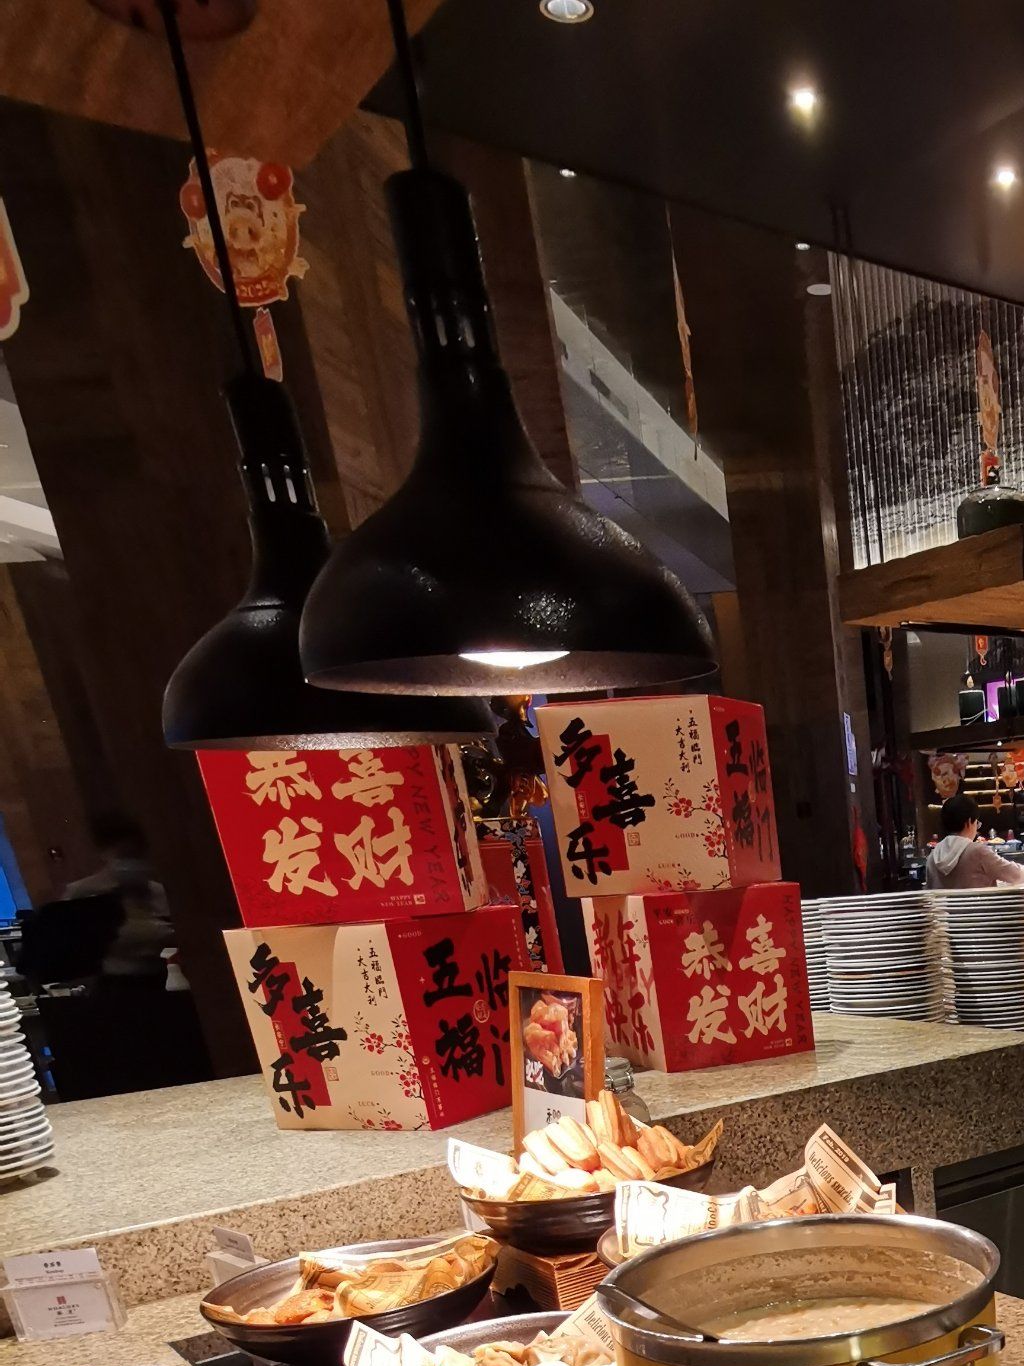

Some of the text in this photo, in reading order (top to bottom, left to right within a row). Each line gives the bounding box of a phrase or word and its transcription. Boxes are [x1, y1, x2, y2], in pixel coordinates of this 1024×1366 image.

[245, 750, 405, 810] 恭喜
[675, 725, 691, 773] 大吉大利
[552, 717, 655, 885] 多喜乐
[262, 806, 416, 896] 发财
[681, 913, 787, 979] 恭喜
[357, 955, 378, 1007] 大吉大利
[423, 937, 486, 1082] 五福
[685, 974, 788, 1045] 发财
[246, 942, 348, 1119] 多喜乐
[821, 1133, 835, 1150] Feb.
[583, 1311, 612, 1348] Delicious
